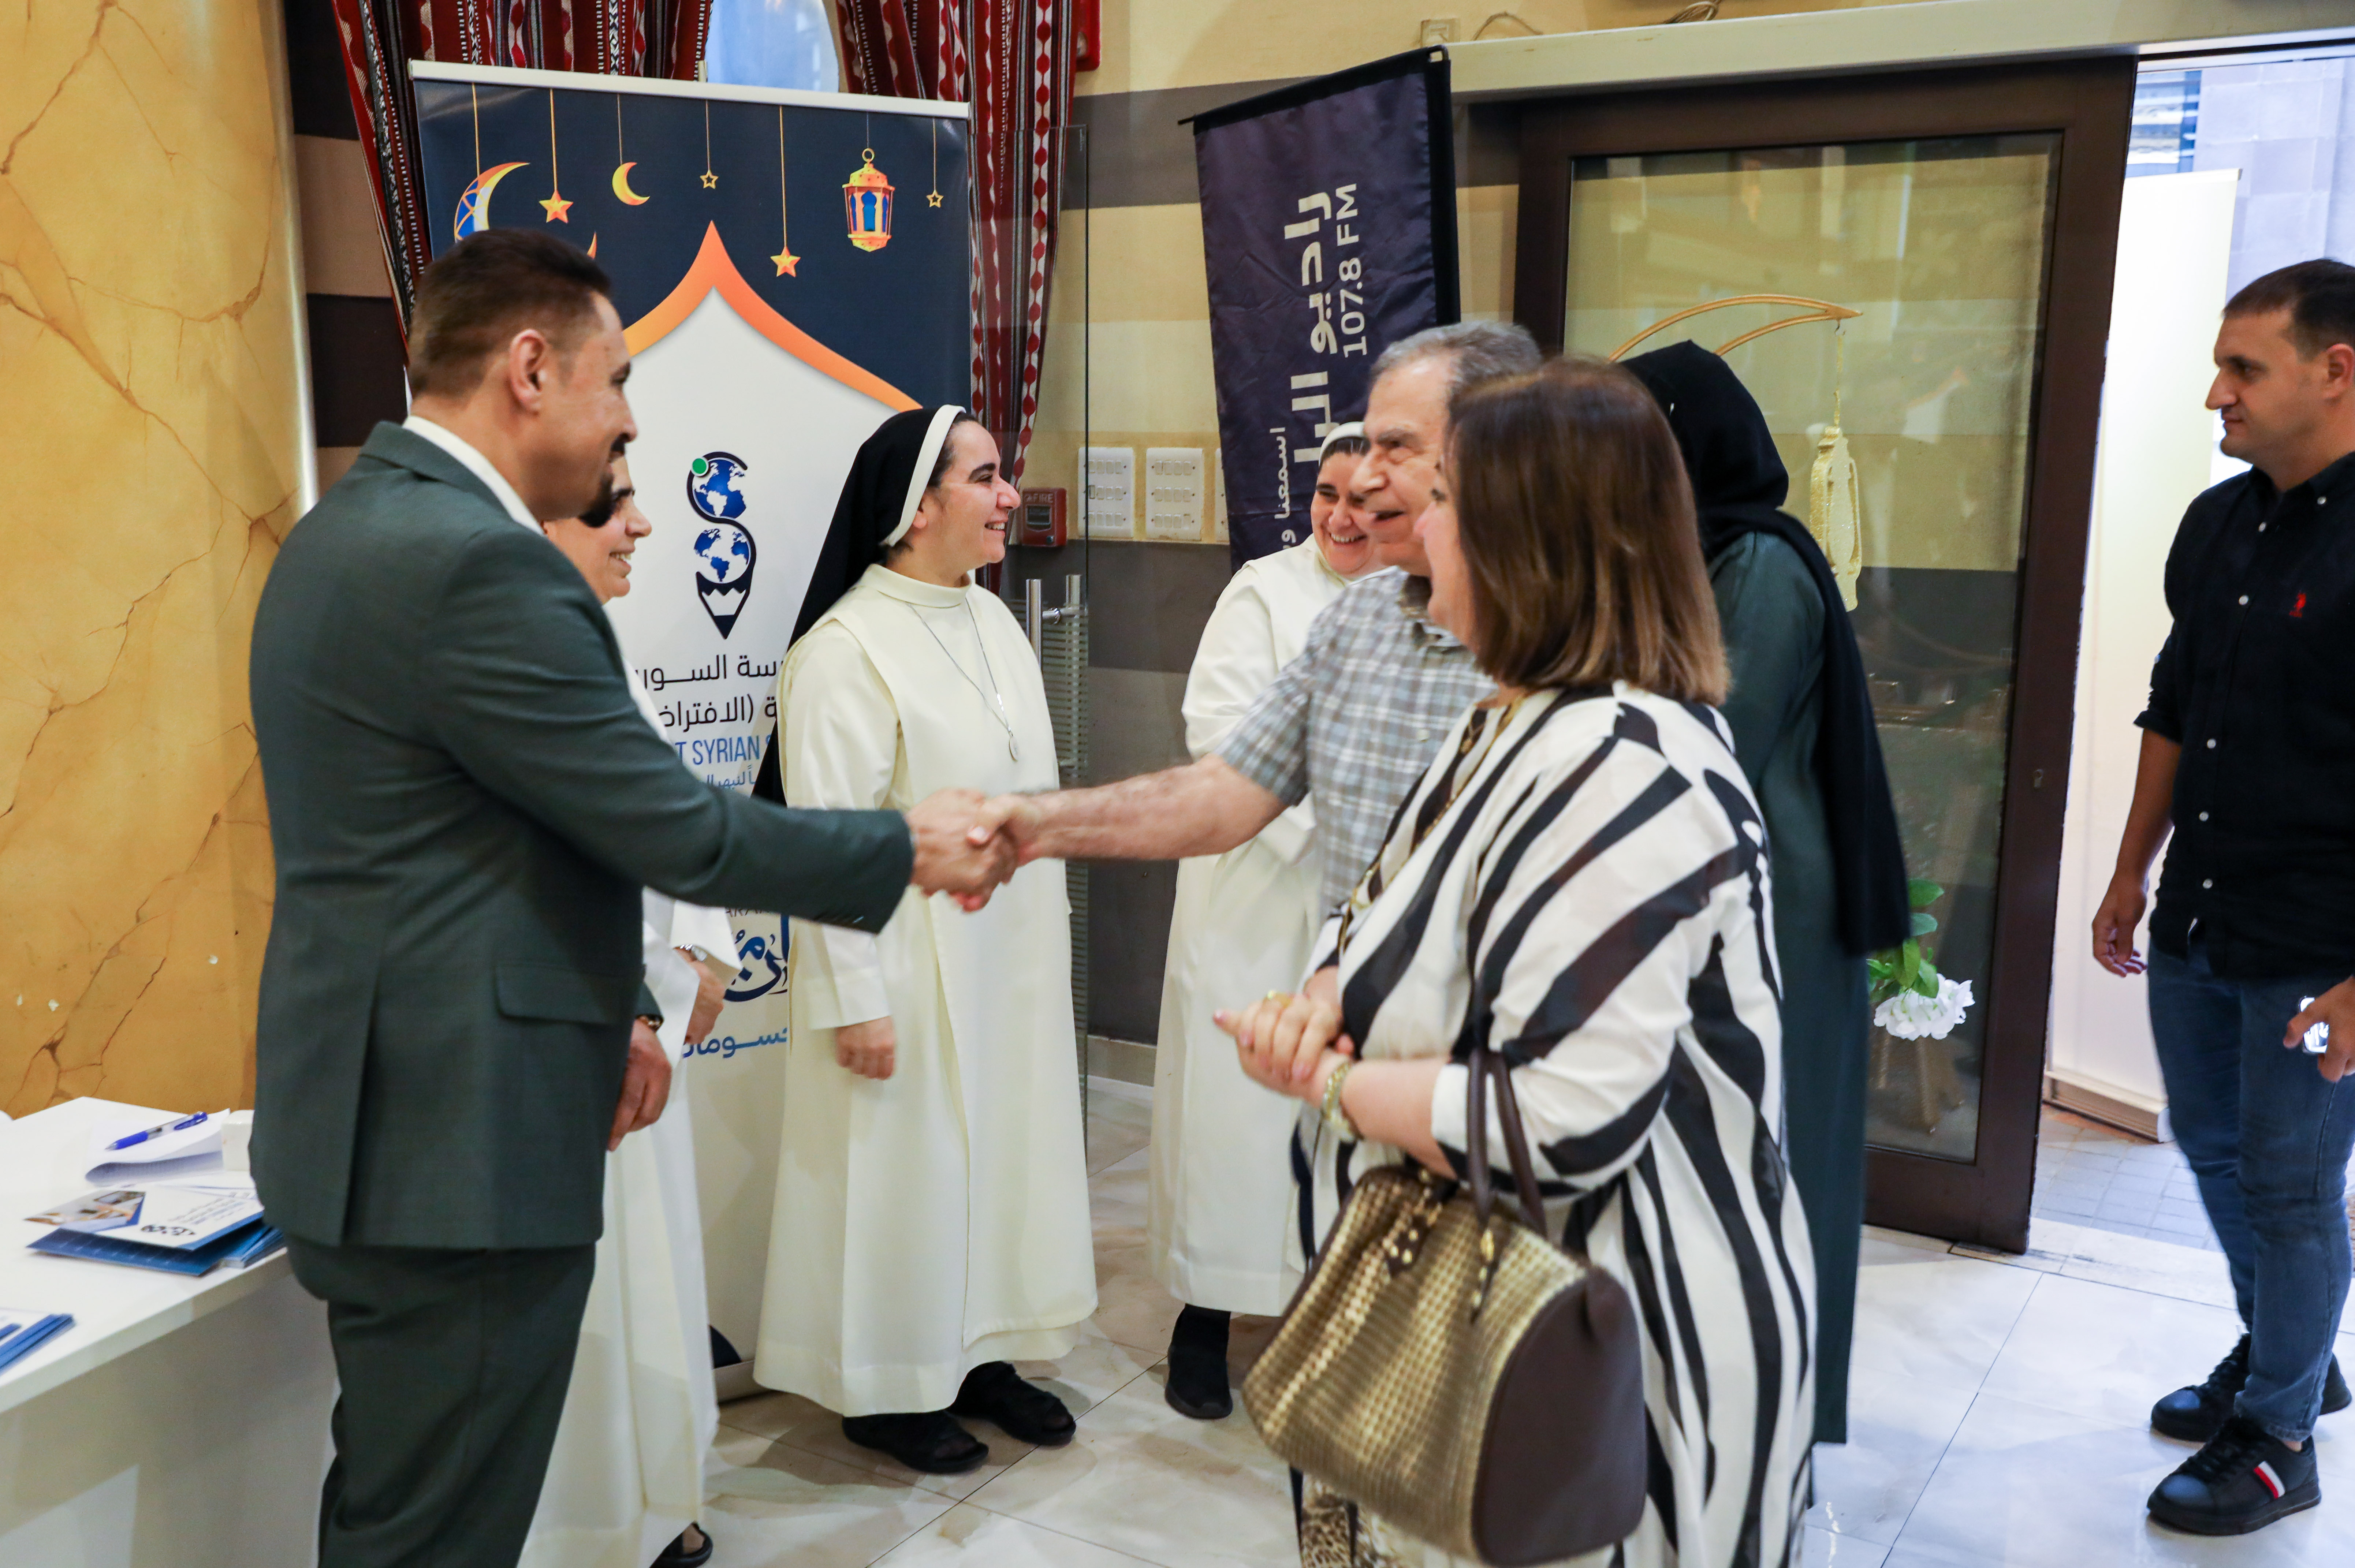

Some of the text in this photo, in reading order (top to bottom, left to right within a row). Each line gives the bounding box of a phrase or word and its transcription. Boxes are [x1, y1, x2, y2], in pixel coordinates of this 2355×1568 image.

[1284, 192, 1338, 355] راديو
[1335, 183, 1368, 358] 107.8 FM
[1270, 427, 1290, 519] اسمعنا
[635, 654, 727, 691] السور
[693, 735, 760, 765] SYRIAN
